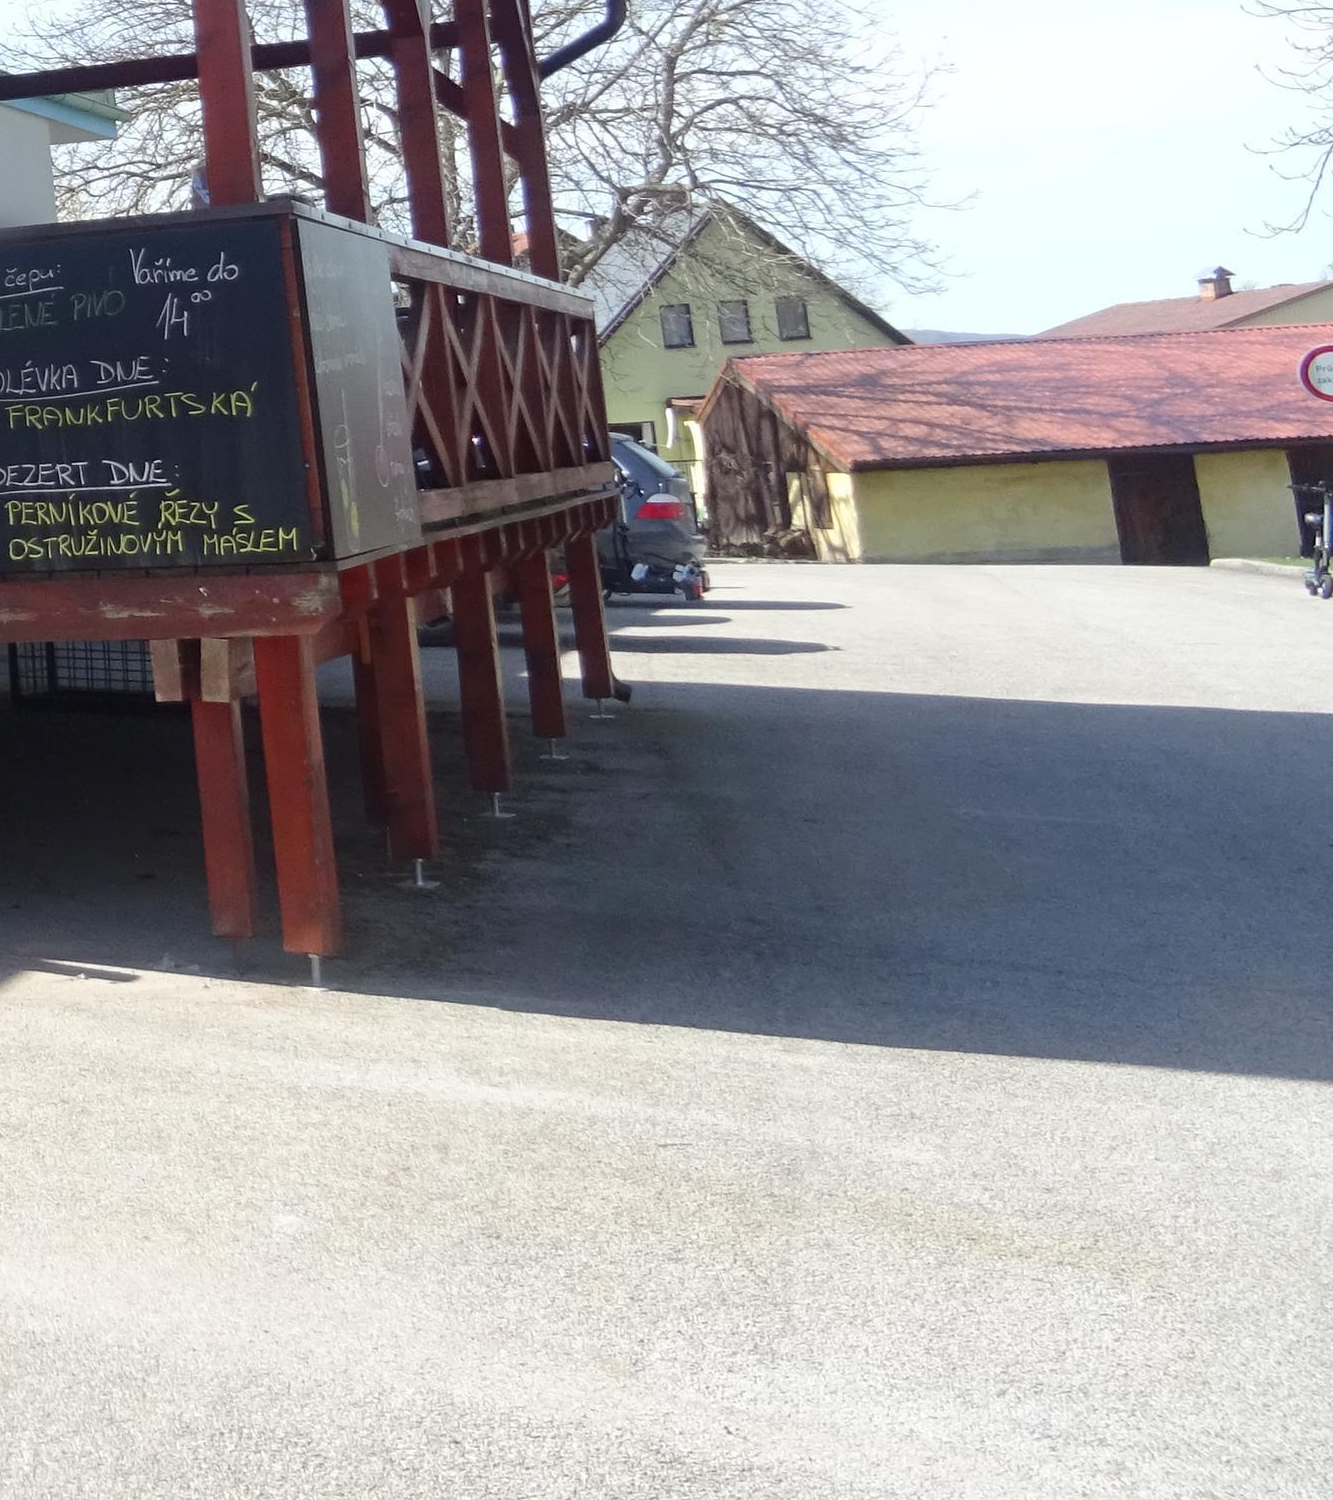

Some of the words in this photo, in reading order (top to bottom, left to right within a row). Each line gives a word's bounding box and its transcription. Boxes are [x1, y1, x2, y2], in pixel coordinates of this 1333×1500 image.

[129, 248, 199, 285] Vaříme
[207, 251, 239, 283] do
[71, 290, 125, 321] PIVO
[5, 382, 260, 430] FRANKFURTSKÁ
[4, 492, 137, 527] PERNÍKOVÉ
[158, 488, 219, 529] ŘEZY
[8, 523, 183, 560] OSTRUŽINOVÝM
[202, 525, 298, 556] MÁSLEM
